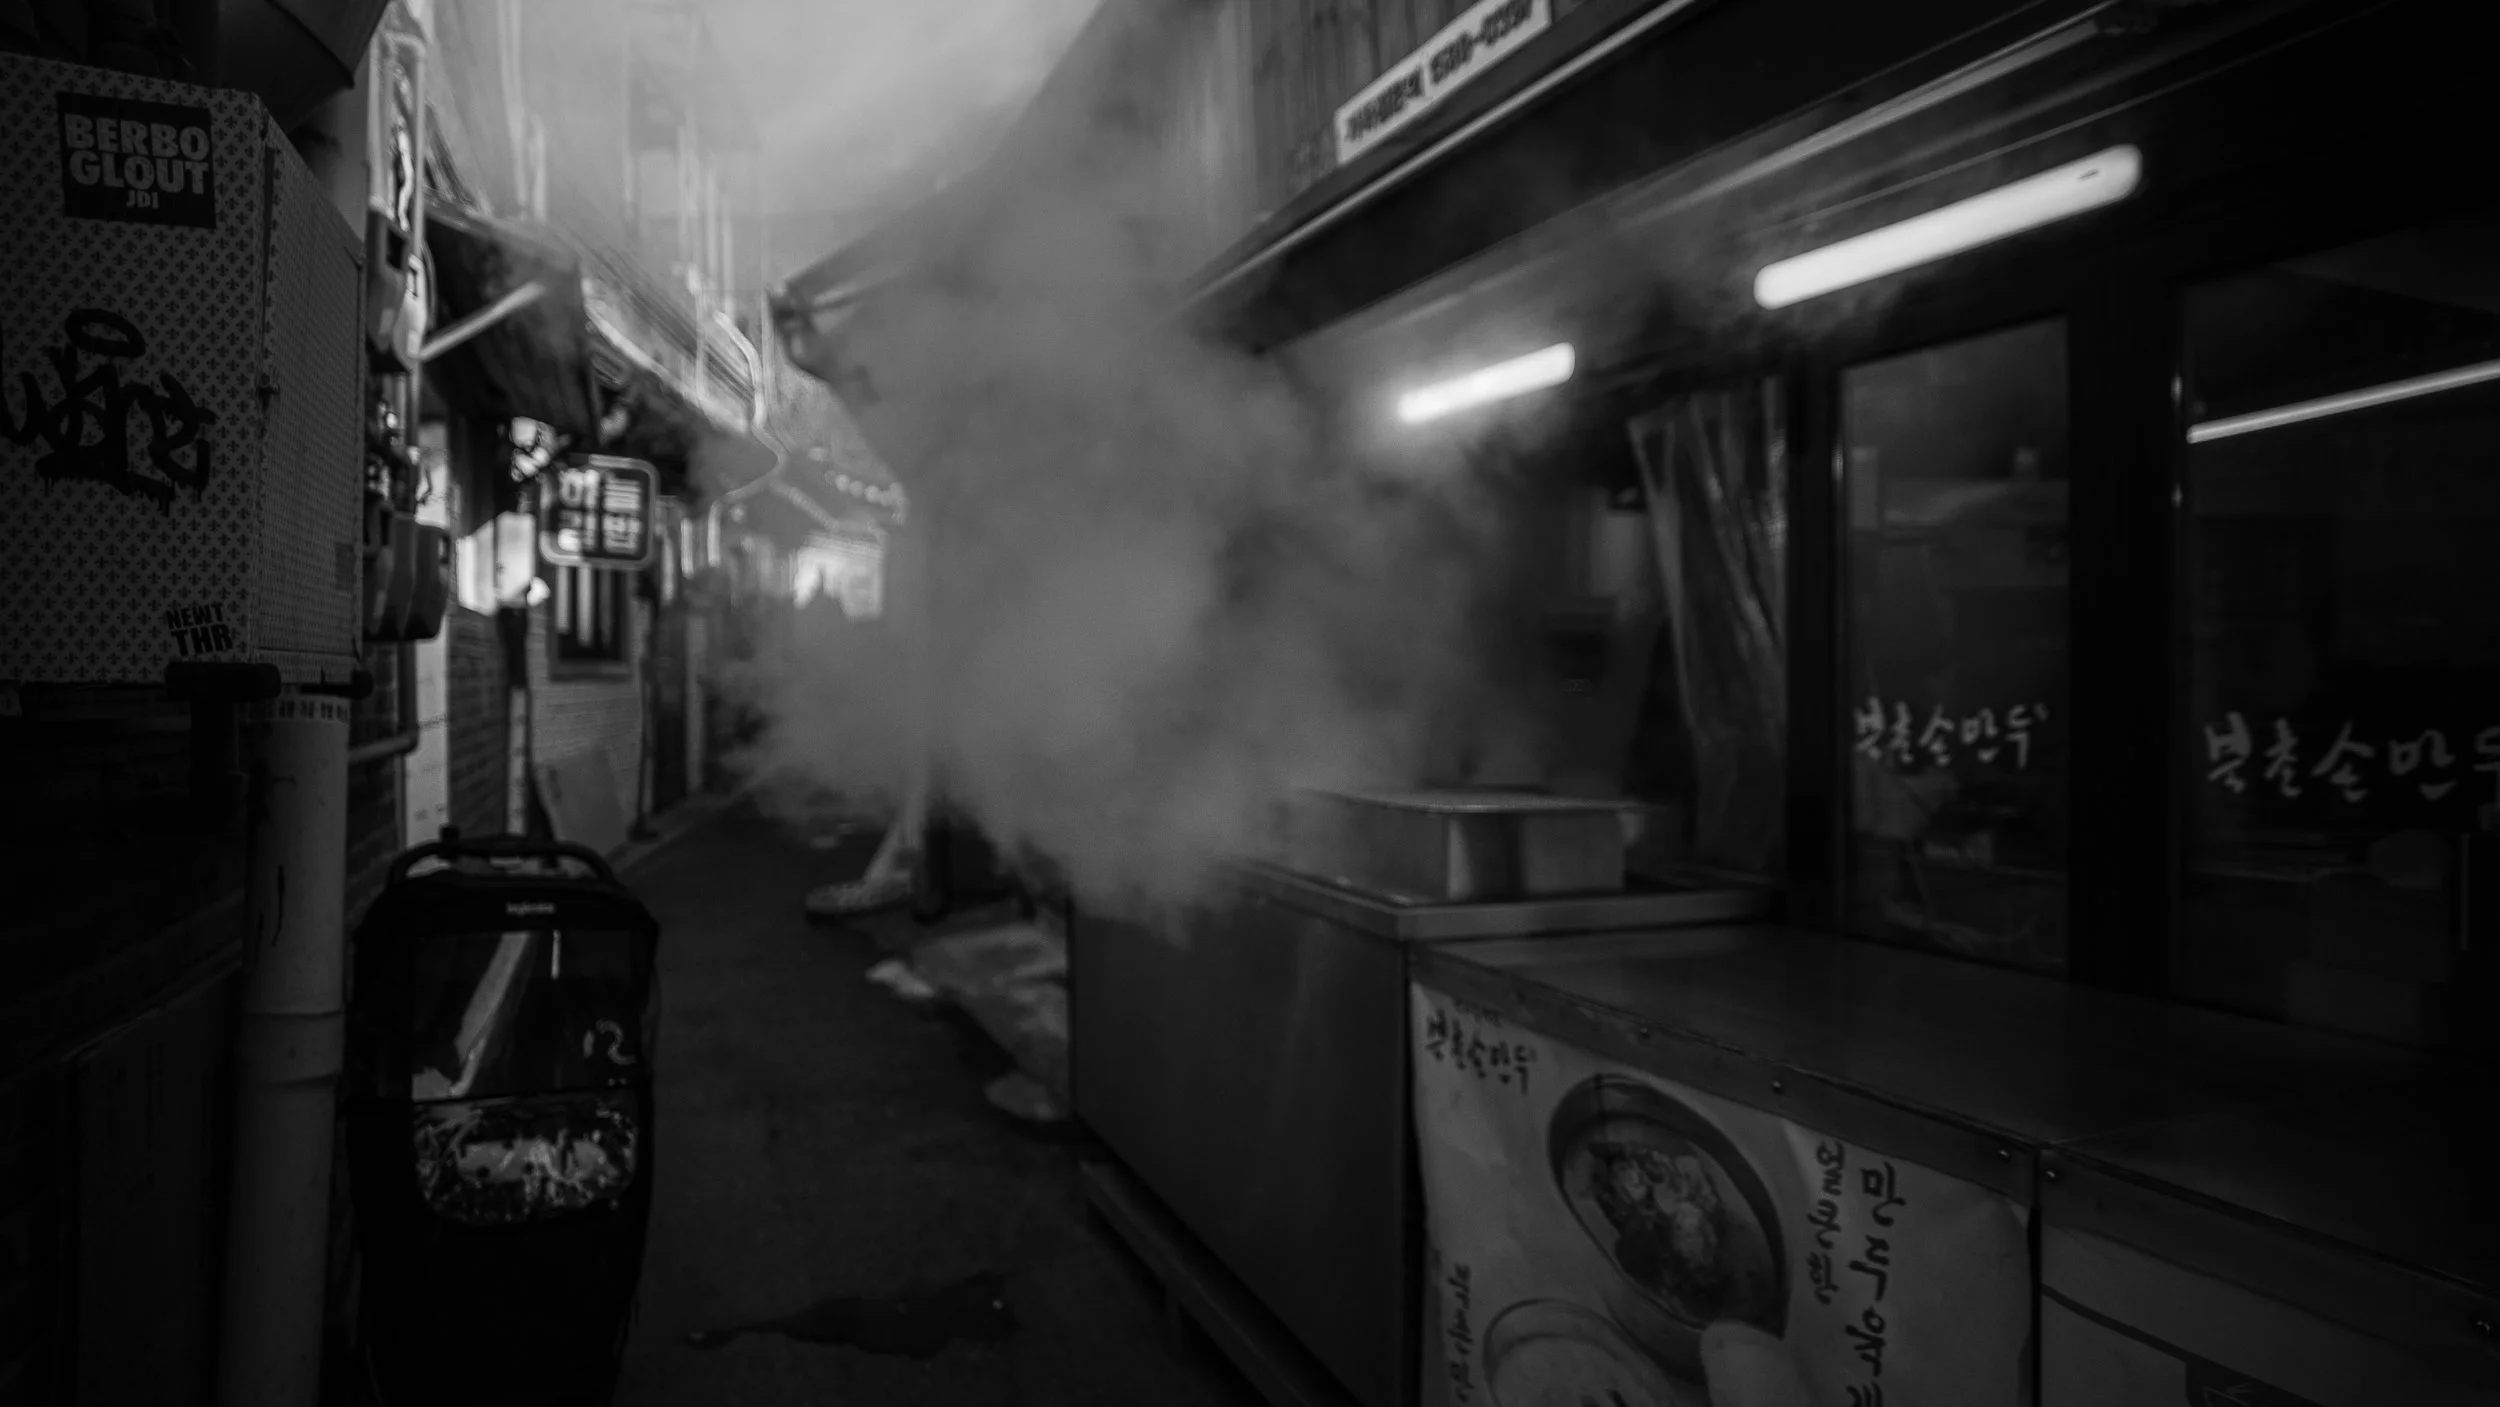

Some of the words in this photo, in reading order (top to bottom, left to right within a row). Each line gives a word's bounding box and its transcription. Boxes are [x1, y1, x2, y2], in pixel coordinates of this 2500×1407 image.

[64, 113, 210, 161] BERBO
[69, 150, 209, 195] GLOUT
[126, 189, 160, 209] JDI
[166, 602, 224, 629] NEWT
[170, 623, 233, 656] THR
[1853, 695, 2049, 770] 북촌손만두
[1425, 1008, 1537, 1096] 북촌손만두
